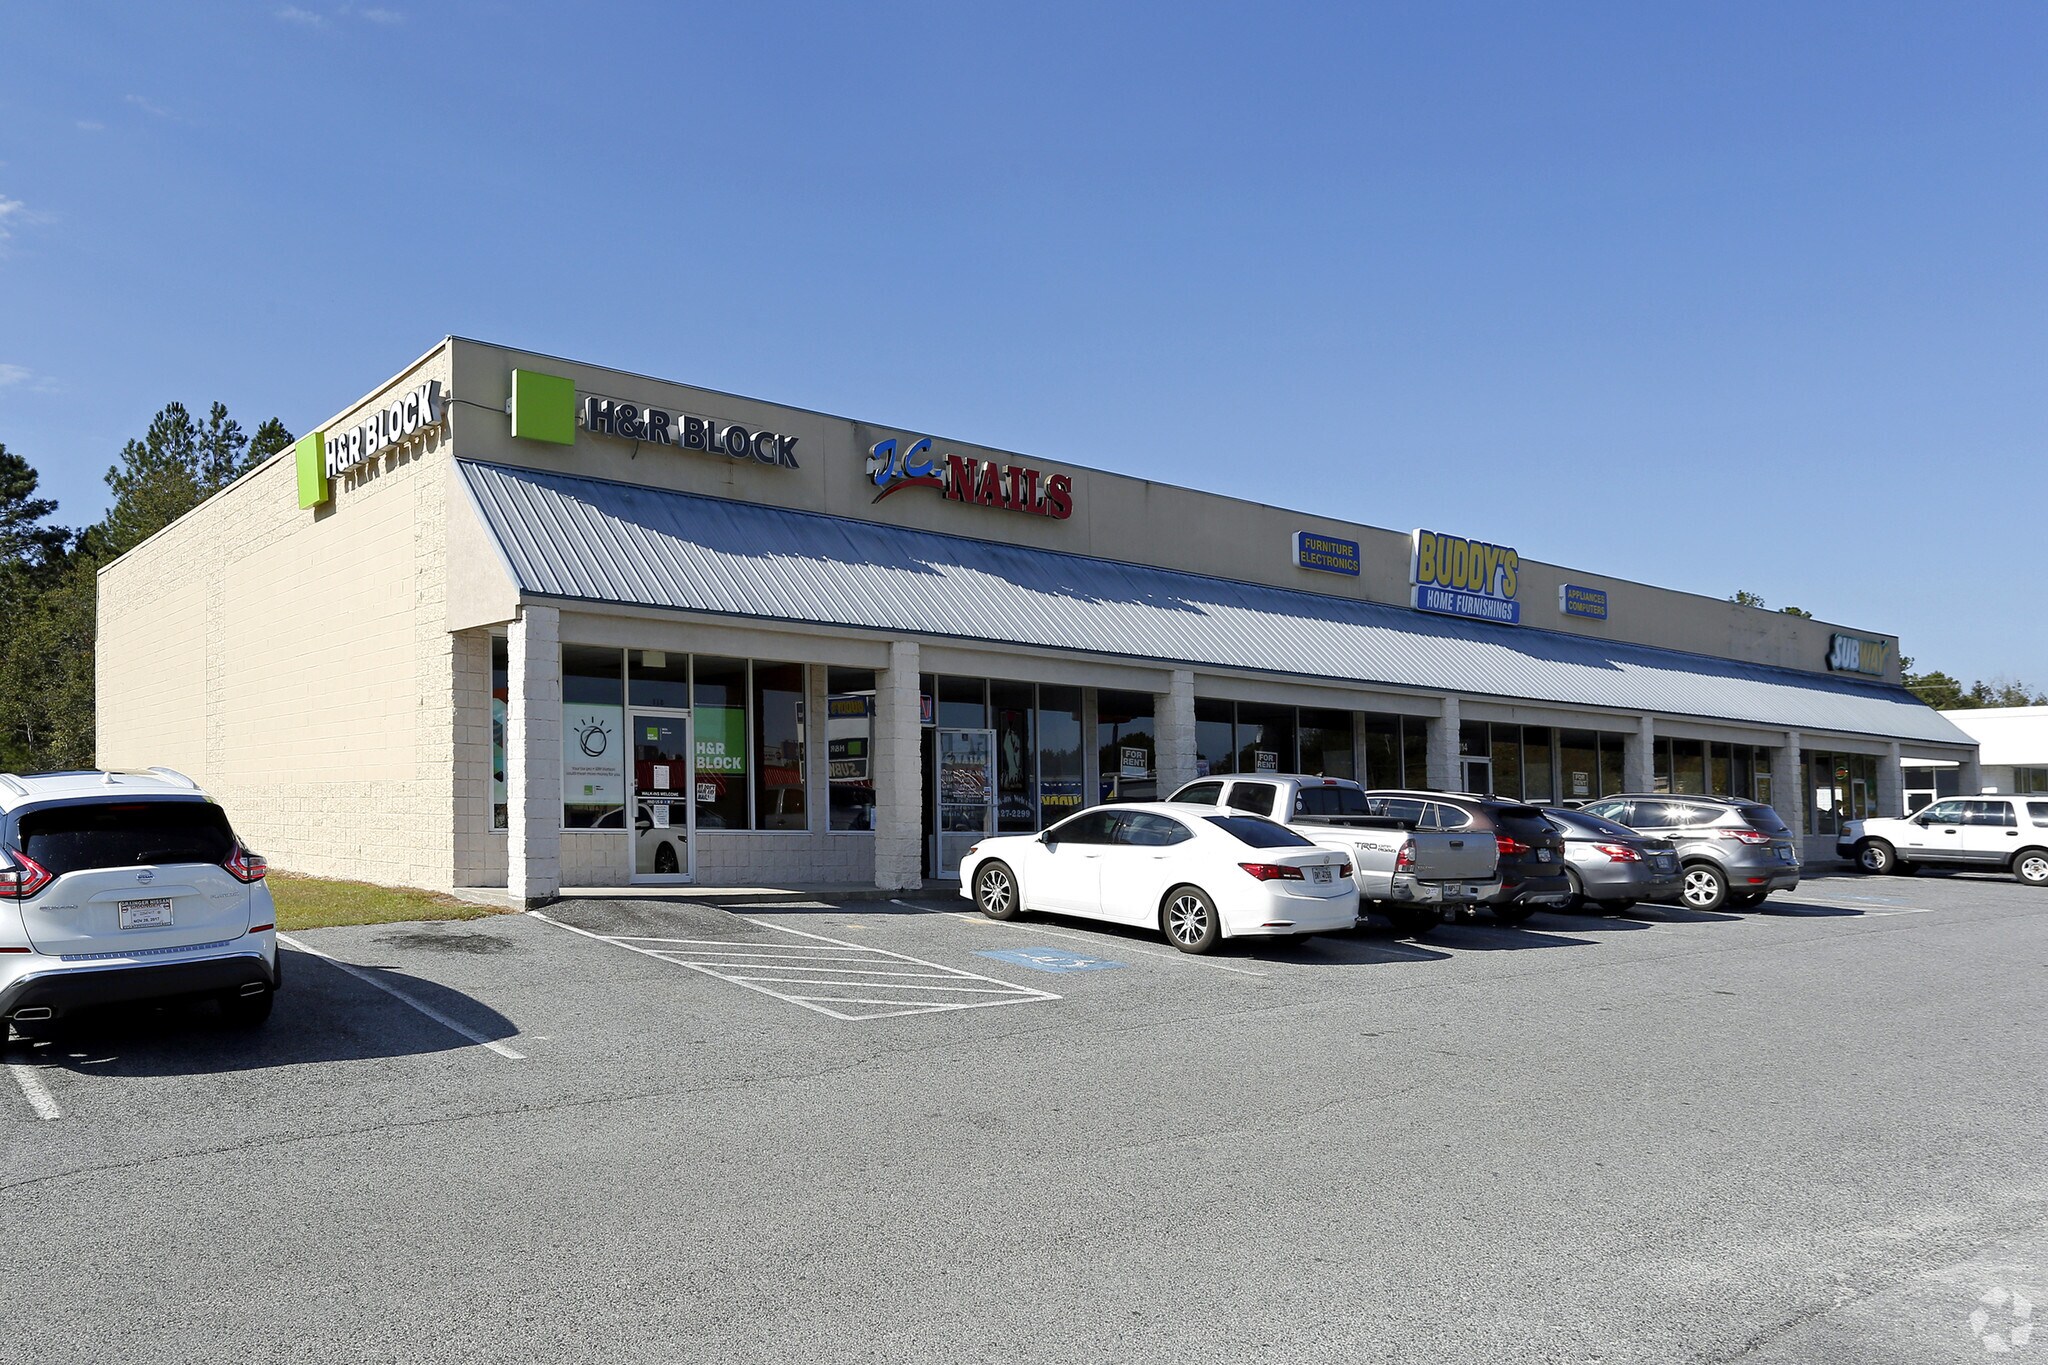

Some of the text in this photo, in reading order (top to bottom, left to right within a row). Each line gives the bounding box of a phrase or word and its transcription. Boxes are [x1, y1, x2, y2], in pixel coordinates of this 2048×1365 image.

[325, 380, 434, 479] H&R BLOCK
[587, 397, 800, 469] H&R BLOCK
[946, 454, 1073, 520] NAILS
[1305, 538, 1353, 556] FURNITURE
[1300, 551, 1359, 571] ELECTRONICS
[1418, 533, 1518, 597] BUDDY'S
[1427, 589, 1513, 620] HOME FURNISHINGS
[1568, 589, 1605, 604] APPLIANCES
[1568, 601, 1605, 616] COMPUTERS
[1831, 636, 1889, 673] SUBWAY
[696, 742, 725, 755] H&R
[1125, 750, 1143, 759] FOR
[696, 756, 742, 769] BLOCK
[1122, 757, 1145, 767] RENT
[1257, 760, 1276, 769] RENT
[1355, 842, 1378, 851] TRD
